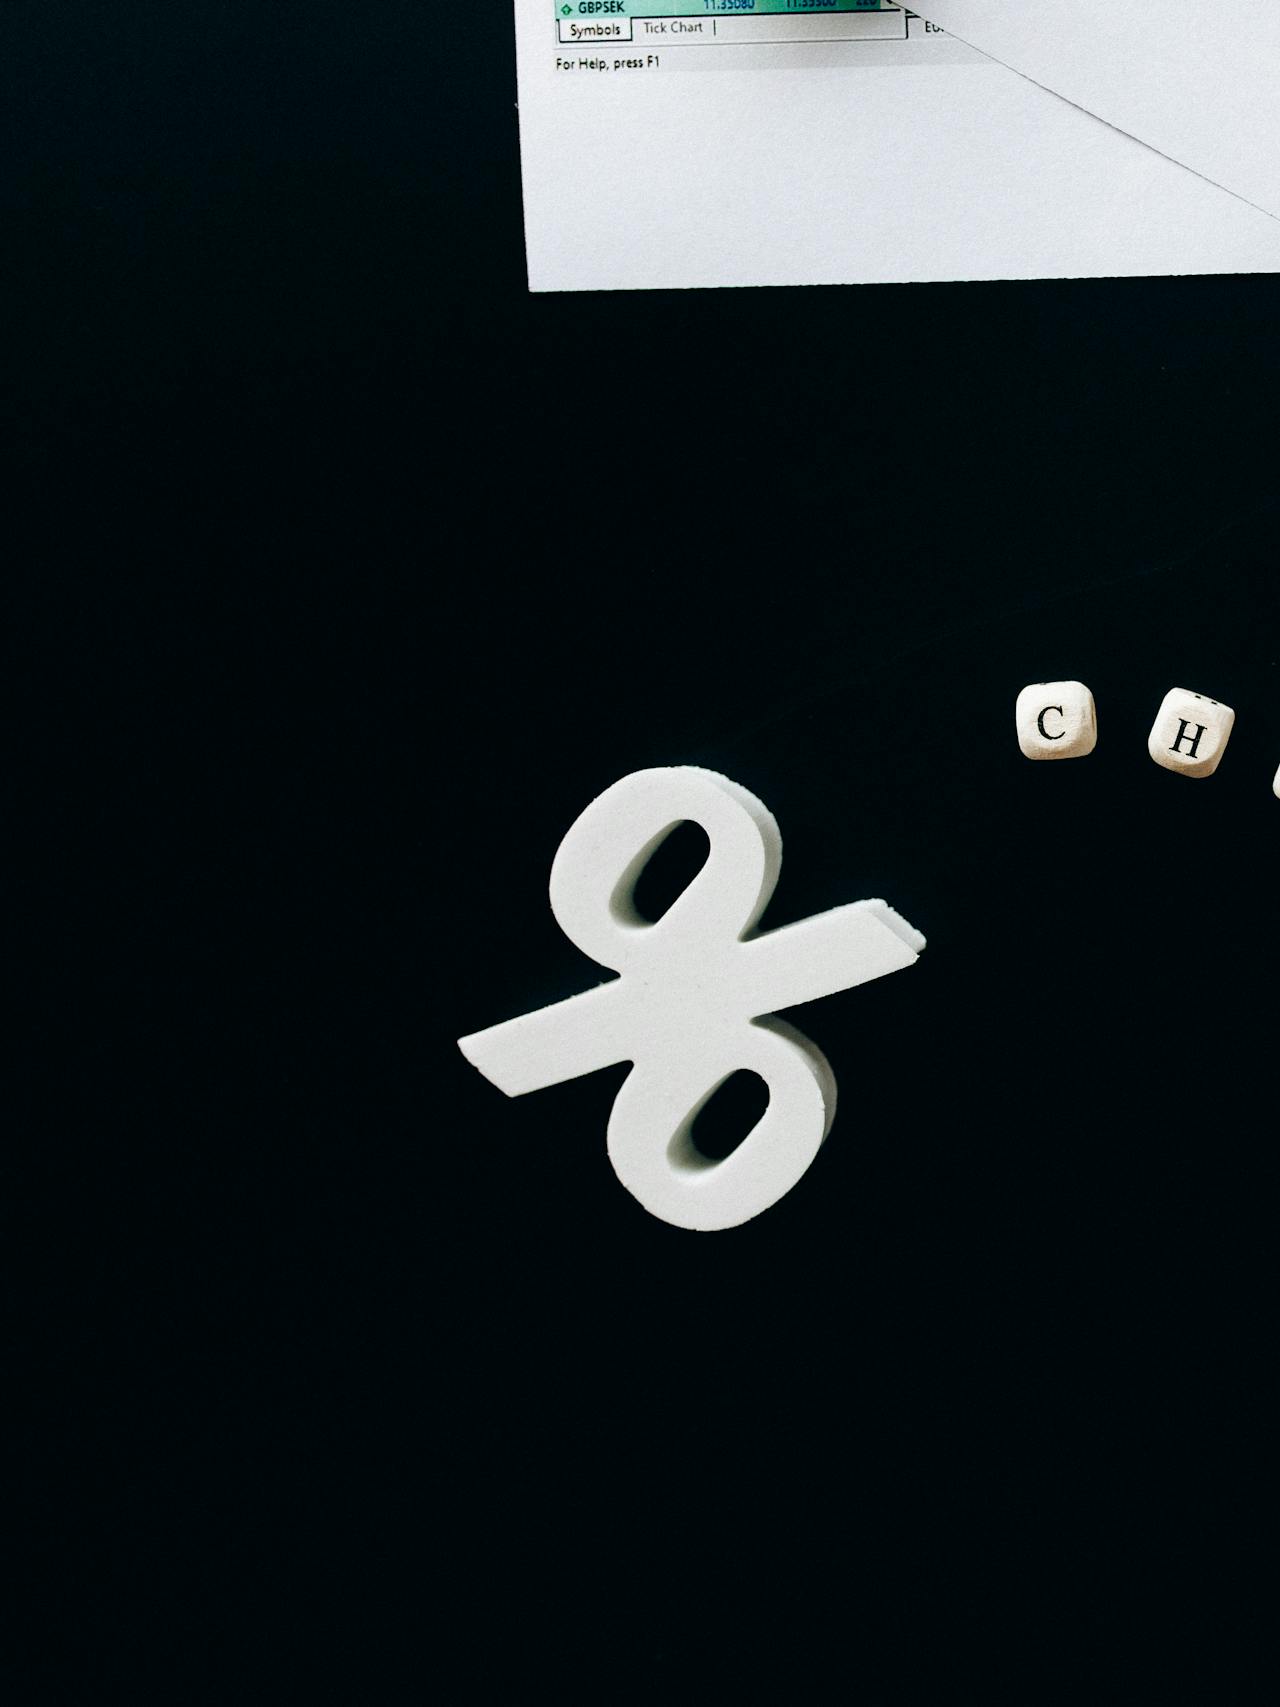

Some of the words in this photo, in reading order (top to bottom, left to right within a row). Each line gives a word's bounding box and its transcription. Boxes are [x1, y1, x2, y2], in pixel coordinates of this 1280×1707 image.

[578, 1, 625, 14] GBPSEK
[570, 23, 621, 38] Symbols
[644, 21, 667, 33] Tick
[671, 21, 704, 33] Chart
[925, 20, 945, 32] EU
[556, 58, 575, 70] For
[579, 57, 609, 71] Help,
[614, 58, 644, 71] press
[647, 55, 660, 67] F1
